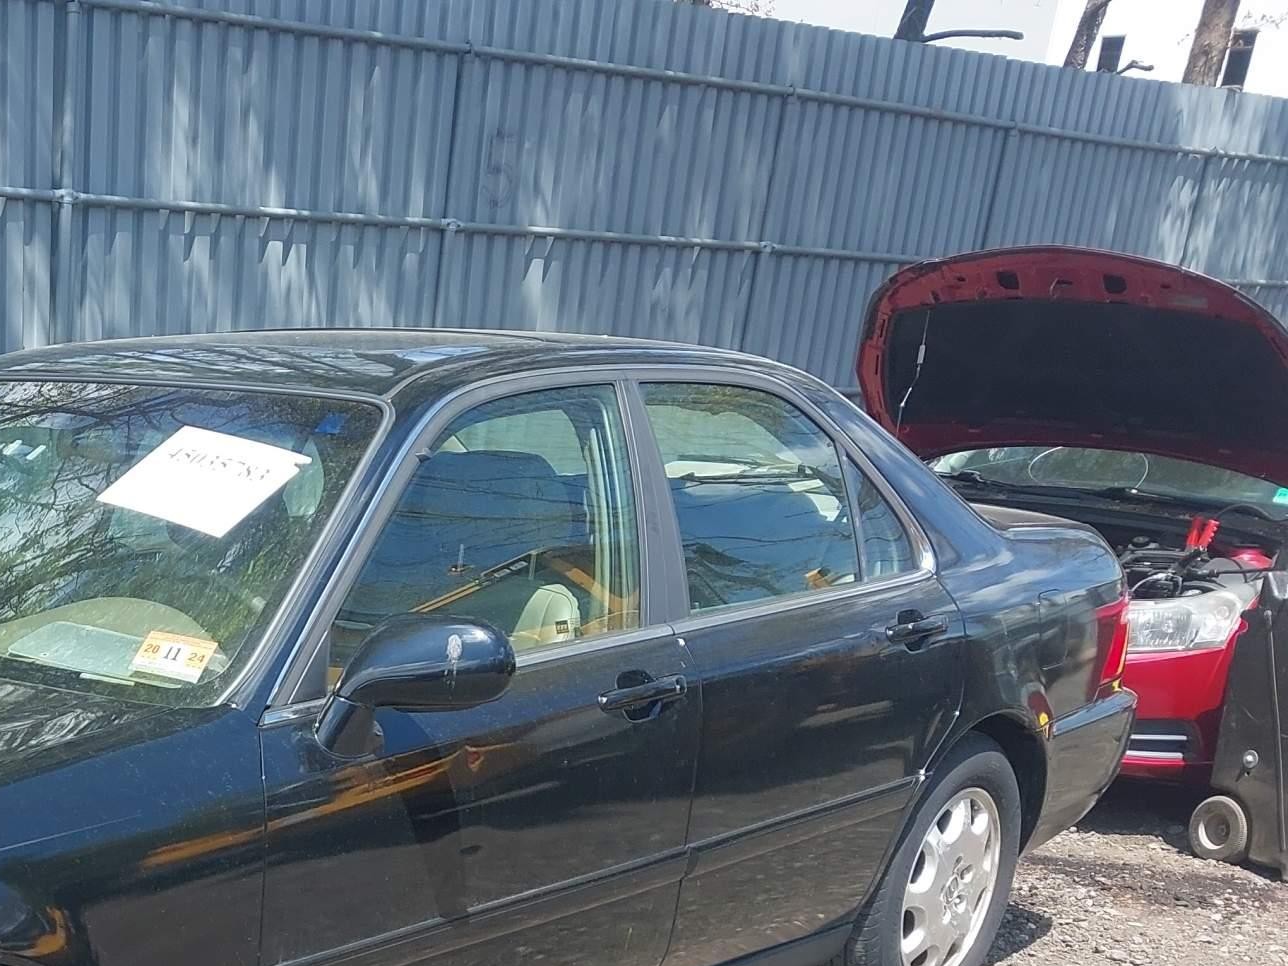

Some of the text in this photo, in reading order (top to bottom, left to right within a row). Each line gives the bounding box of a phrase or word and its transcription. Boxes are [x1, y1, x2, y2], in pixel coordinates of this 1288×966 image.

[143, 643, 161, 655] 20
[162, 645, 182, 662] 11
[187, 651, 206, 663] 24
